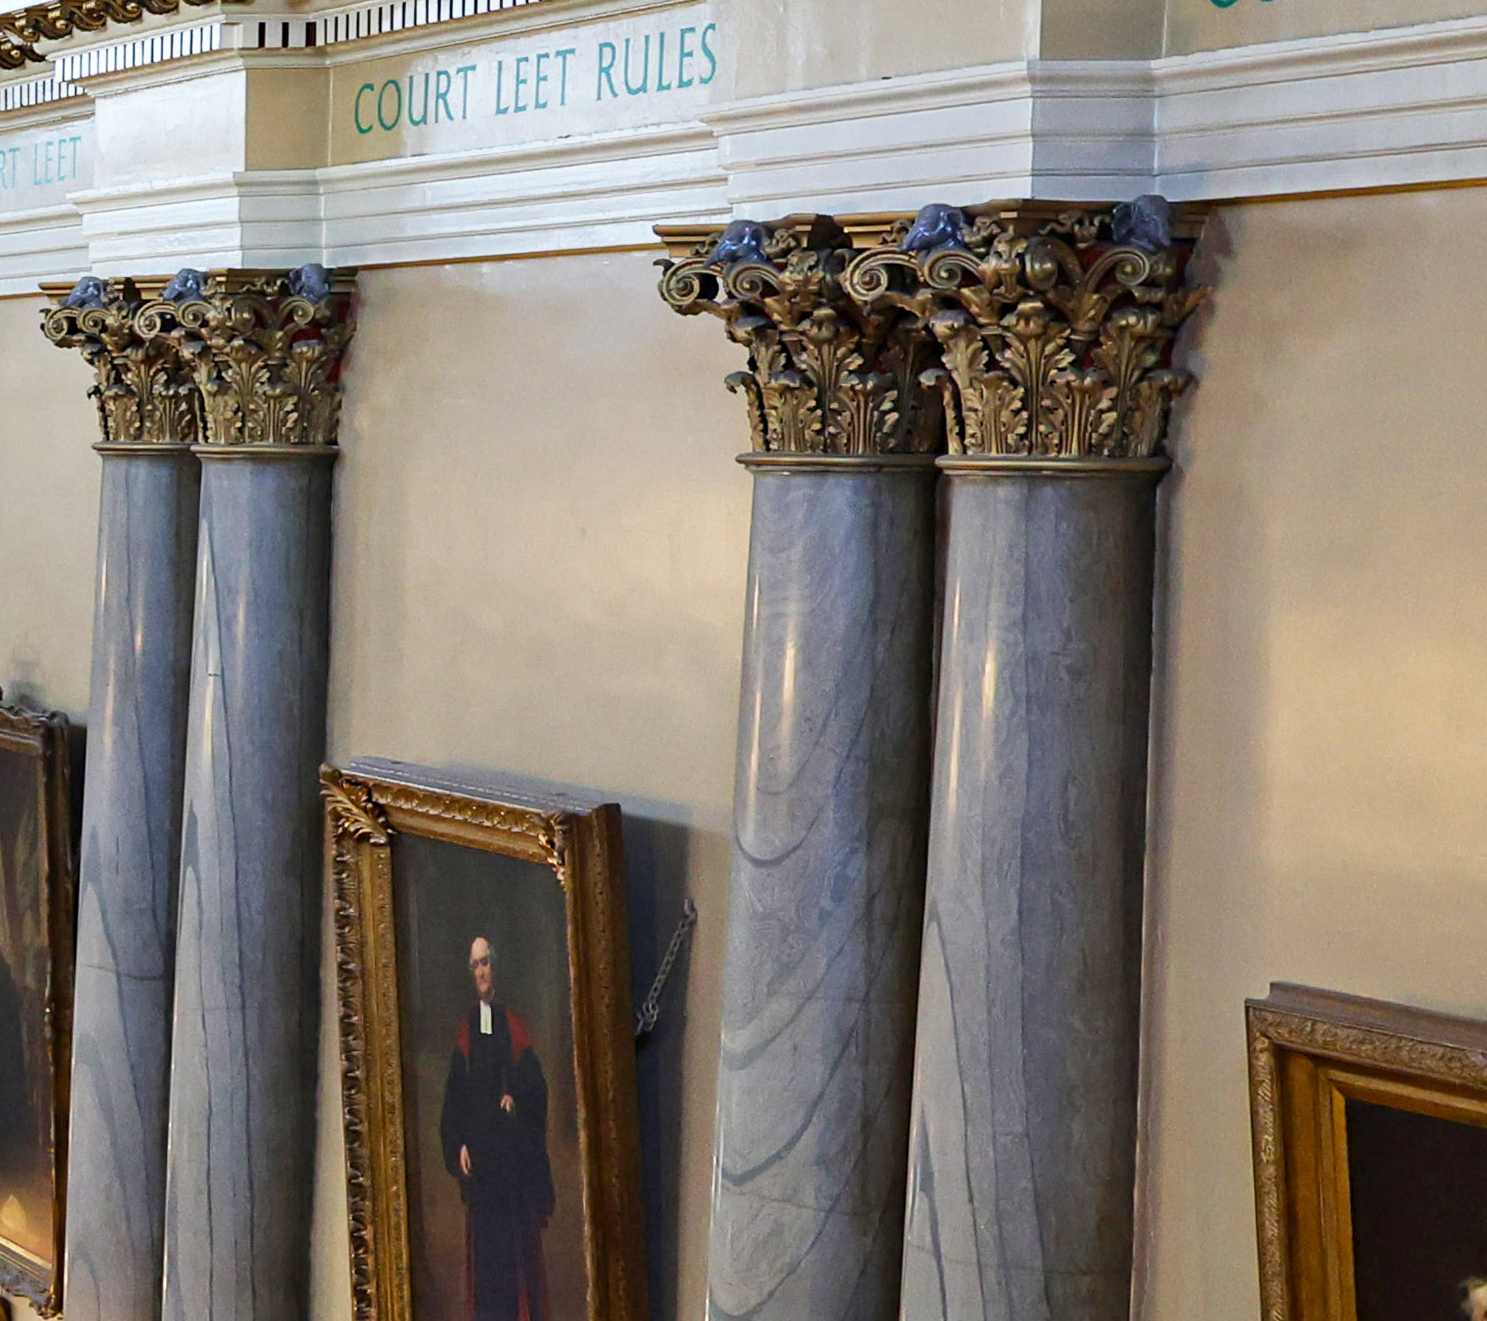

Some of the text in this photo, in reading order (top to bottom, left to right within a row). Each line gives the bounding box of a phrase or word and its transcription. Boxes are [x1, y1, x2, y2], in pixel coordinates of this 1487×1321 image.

[354, 22, 717, 134] COURT LEET RULES
[33, 135, 82, 186] LEET
